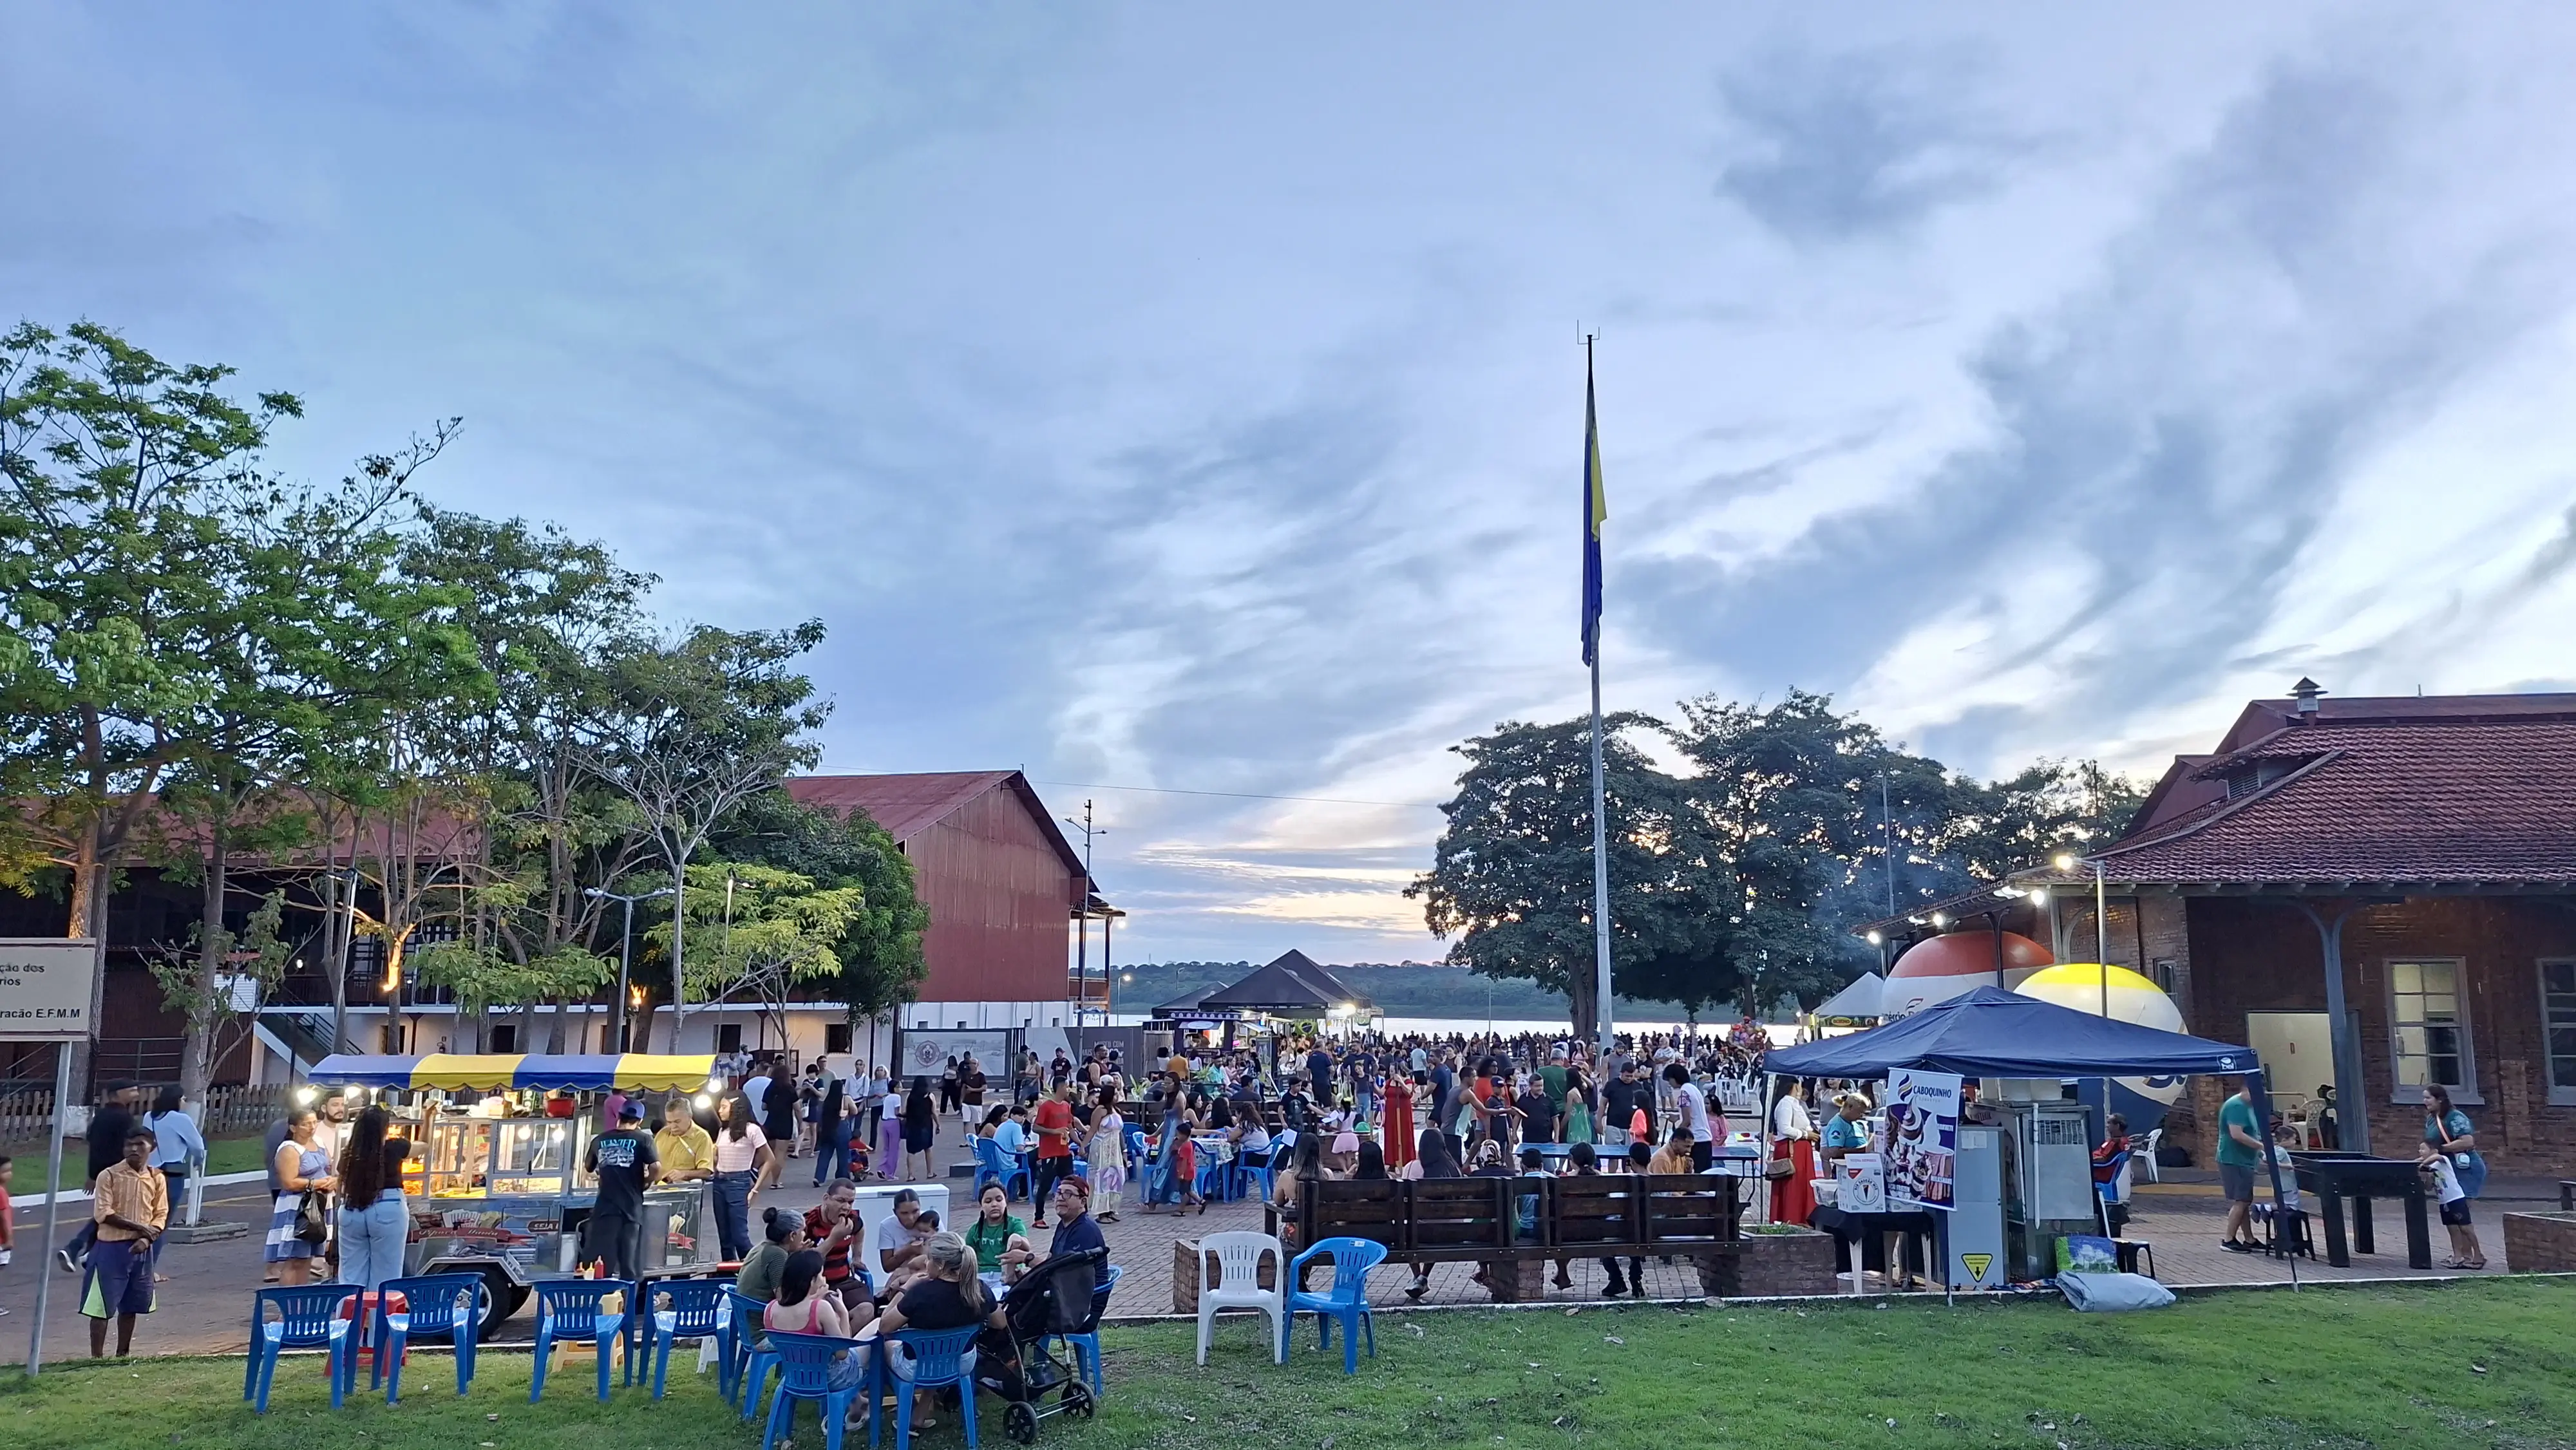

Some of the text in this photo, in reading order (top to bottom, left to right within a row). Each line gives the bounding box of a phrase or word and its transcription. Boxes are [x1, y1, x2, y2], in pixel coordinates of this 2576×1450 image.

[23, 963, 44, 973] dos
[36, 1009, 80, 1018] E.F.M.M
[1913, 1084, 1951, 1098] CABOQUINHO
